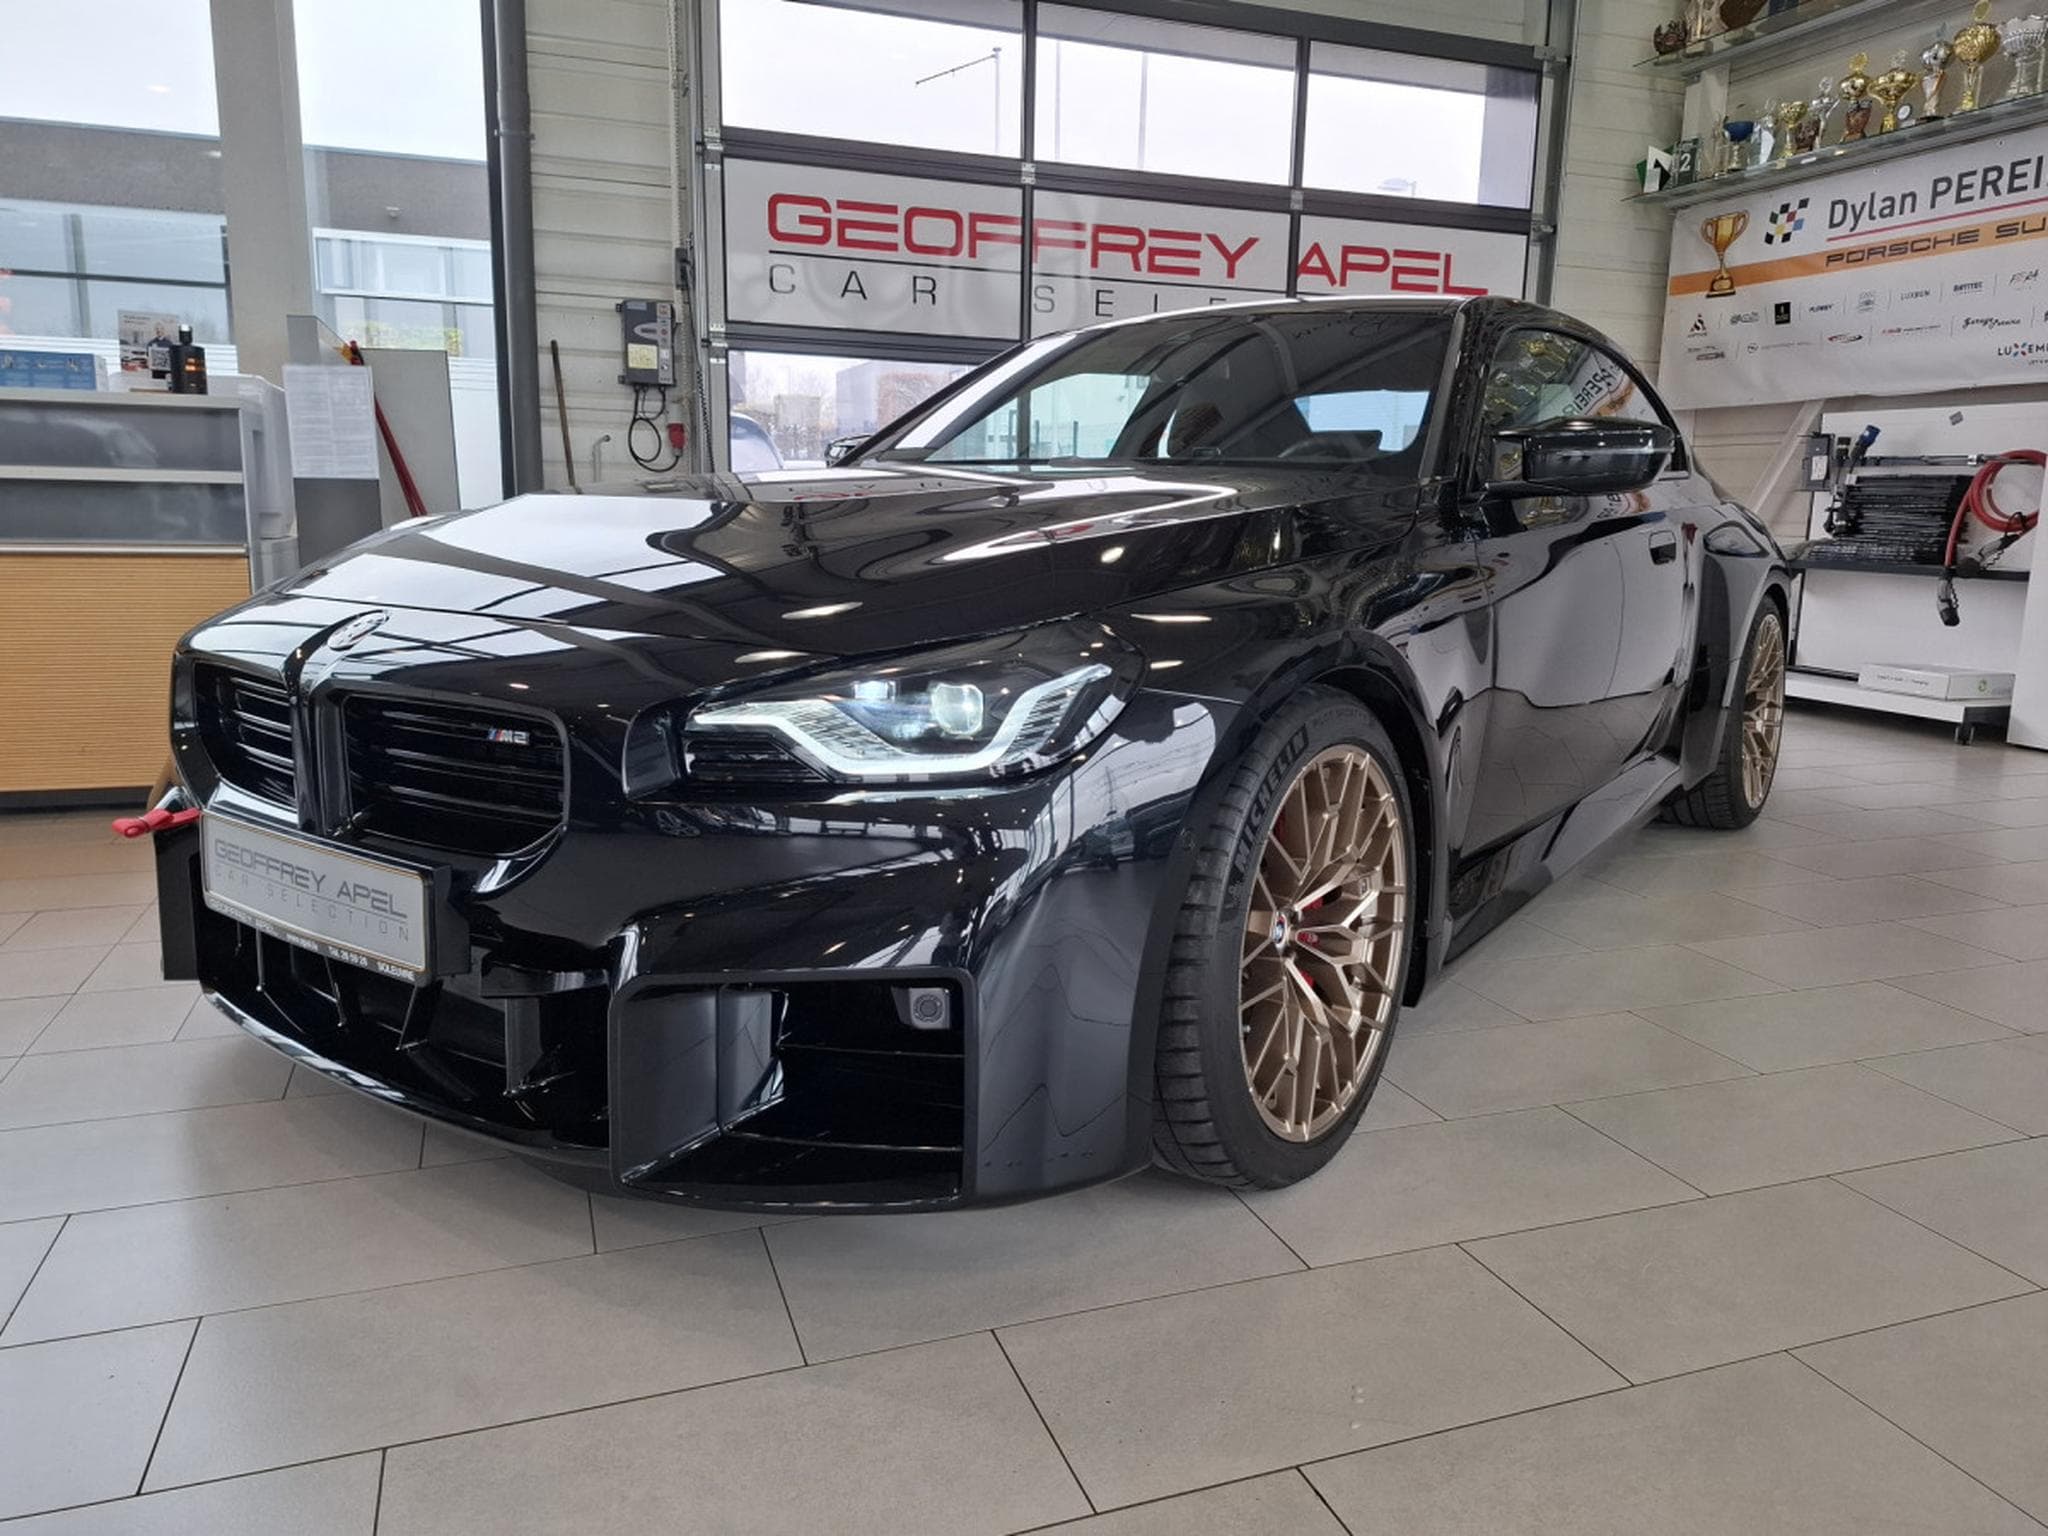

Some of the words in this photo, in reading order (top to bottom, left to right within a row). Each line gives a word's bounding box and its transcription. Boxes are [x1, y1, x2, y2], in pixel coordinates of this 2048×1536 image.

[1828, 191, 1918, 232] Dylan
[1930, 155, 2048, 209] PEREI
[767, 193, 1260, 280] GEOFFREY
[1296, 242, 1488, 296] APEL
[1825, 229, 1980, 267] PORSCHE
[768, 264, 937, 305] CAR
[1997, 341, 2048, 358] LUXEM
[494, 728, 530, 745] M2
[1234, 723, 1309, 871] MICHELIN
[214, 839, 326, 893] GEOFFREY
[337, 880, 407, 919] APEL
